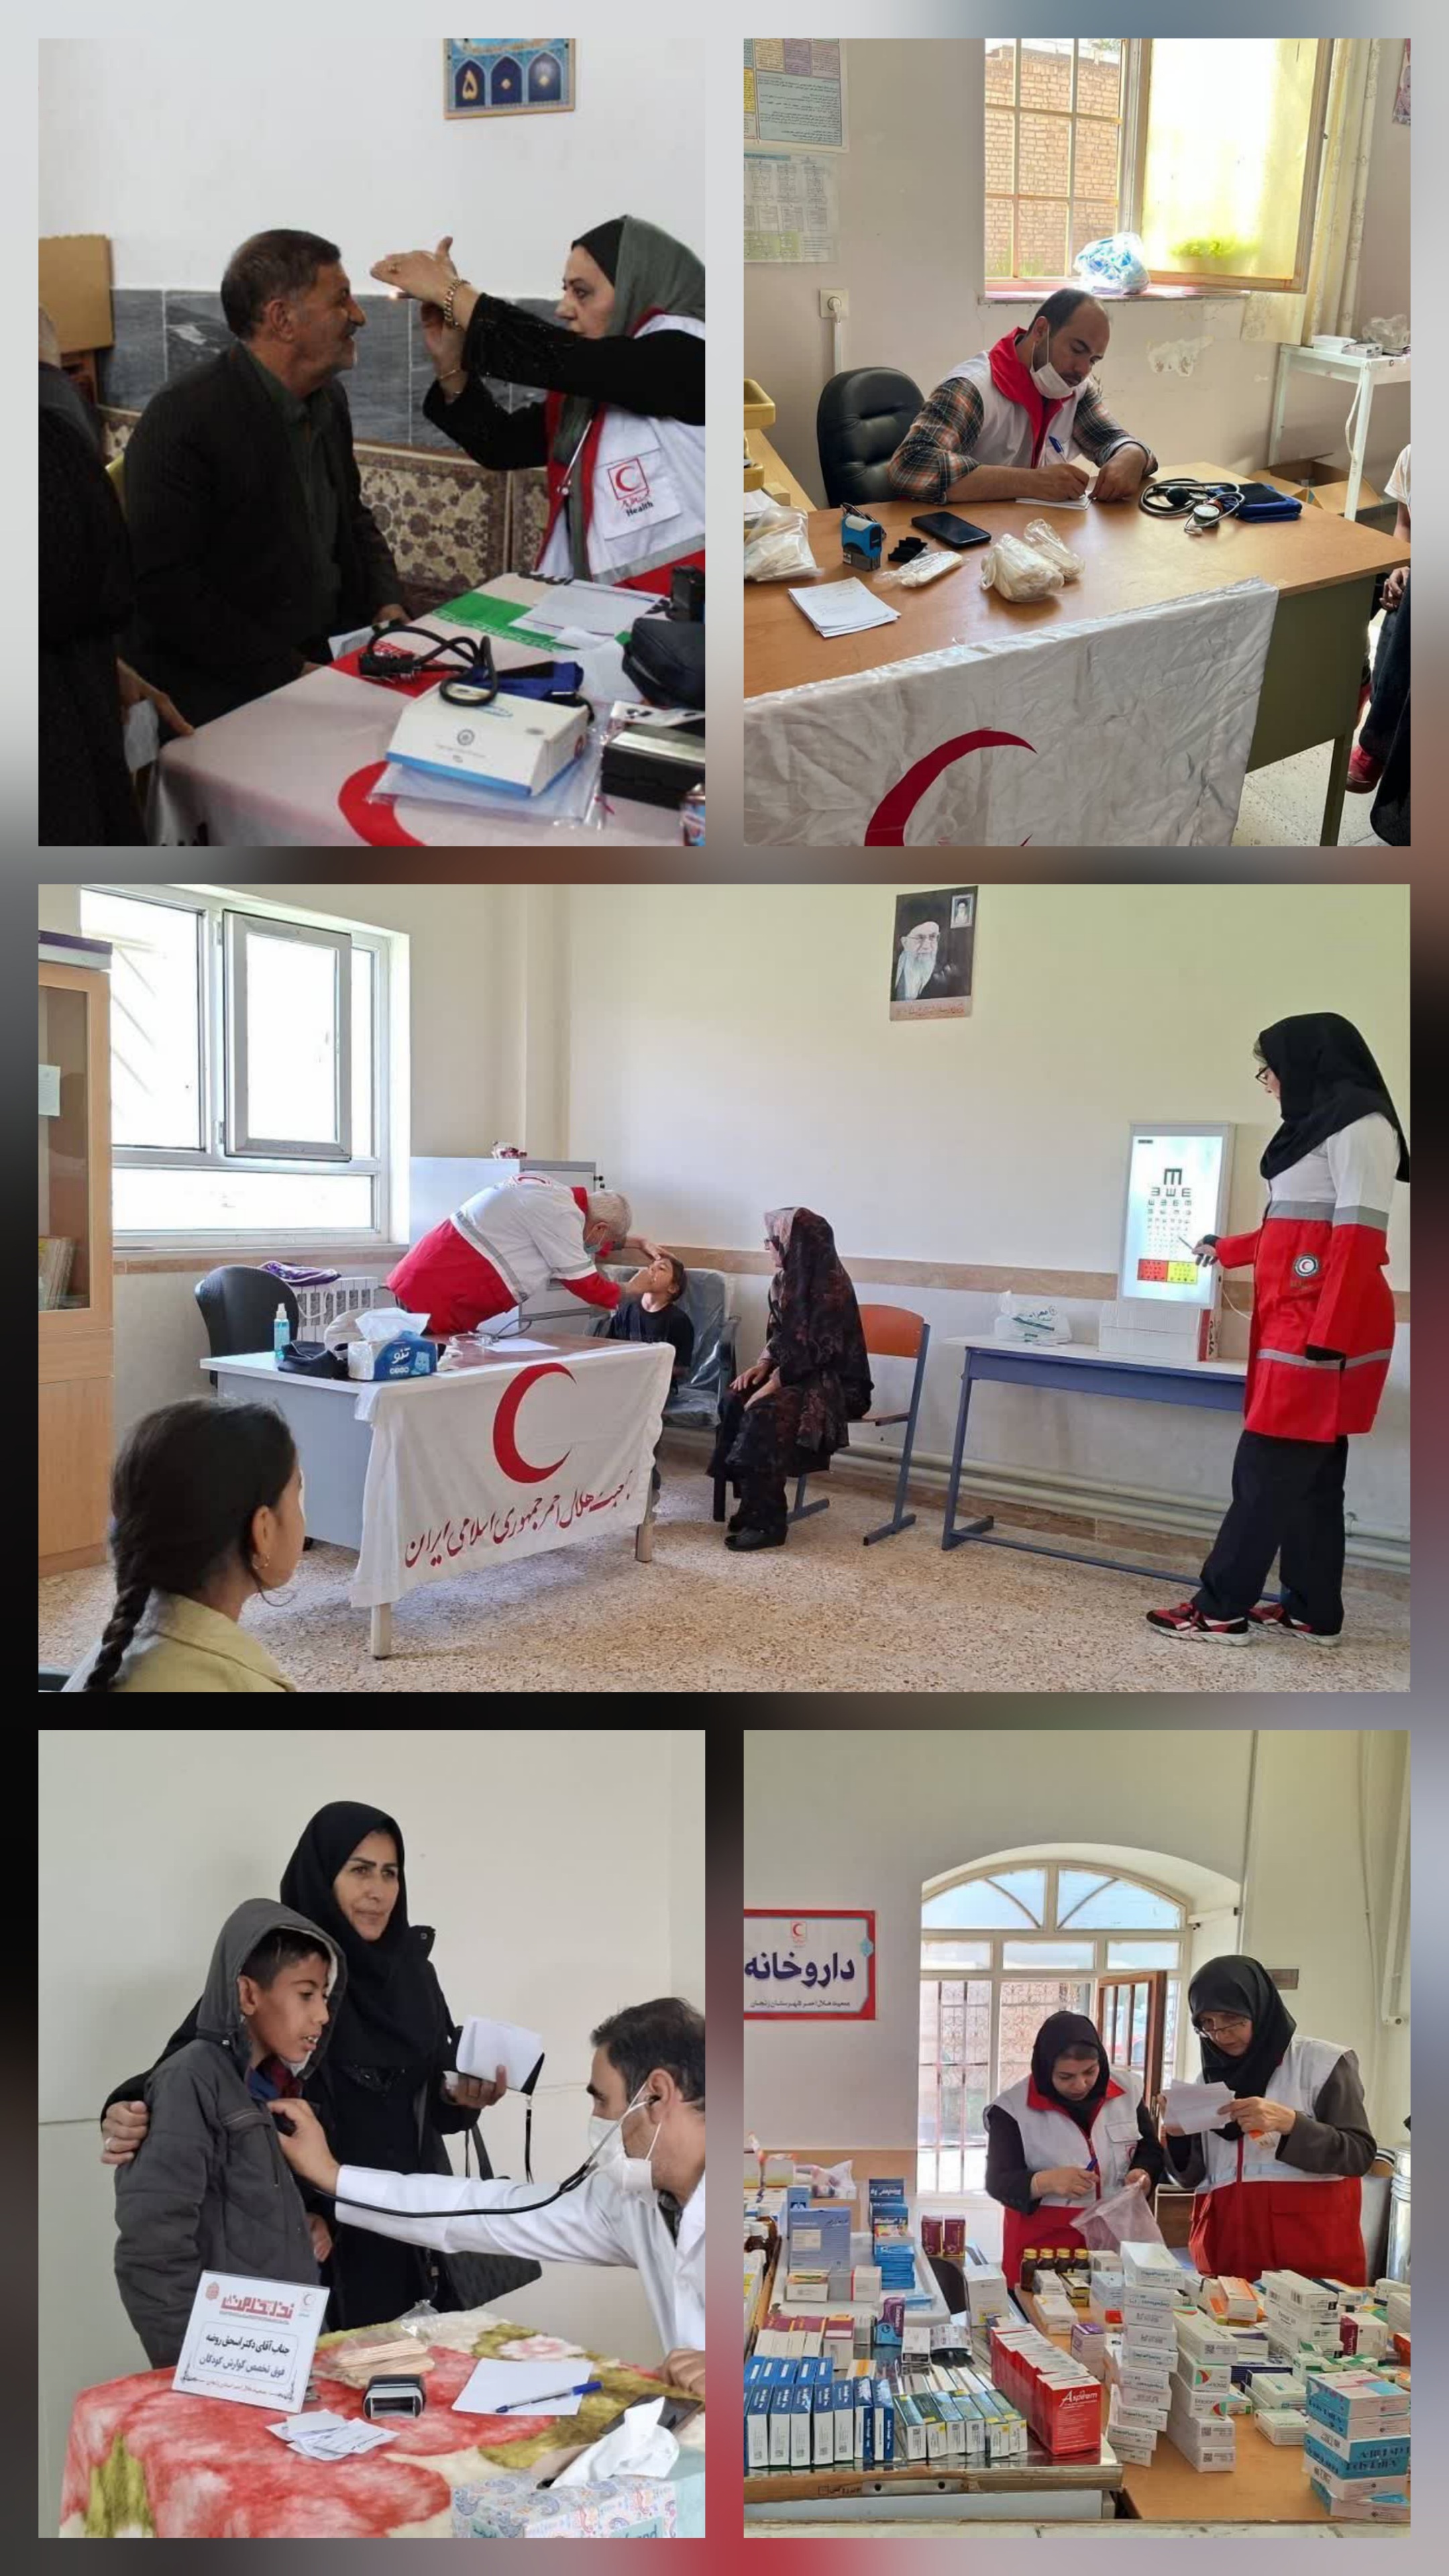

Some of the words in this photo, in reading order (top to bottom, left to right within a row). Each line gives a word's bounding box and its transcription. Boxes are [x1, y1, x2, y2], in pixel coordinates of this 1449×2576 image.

[626, 501, 654, 517] Health
[405, 1520, 451, 1568] ایران
[745, 1951, 855, 1988] داروخانه
[239, 2339, 256, 2350] دکتر
[255, 2339, 273, 2353] آقای
[271, 2344, 290, 2356] جناب
[270, 2368, 285, 2378] فوق
